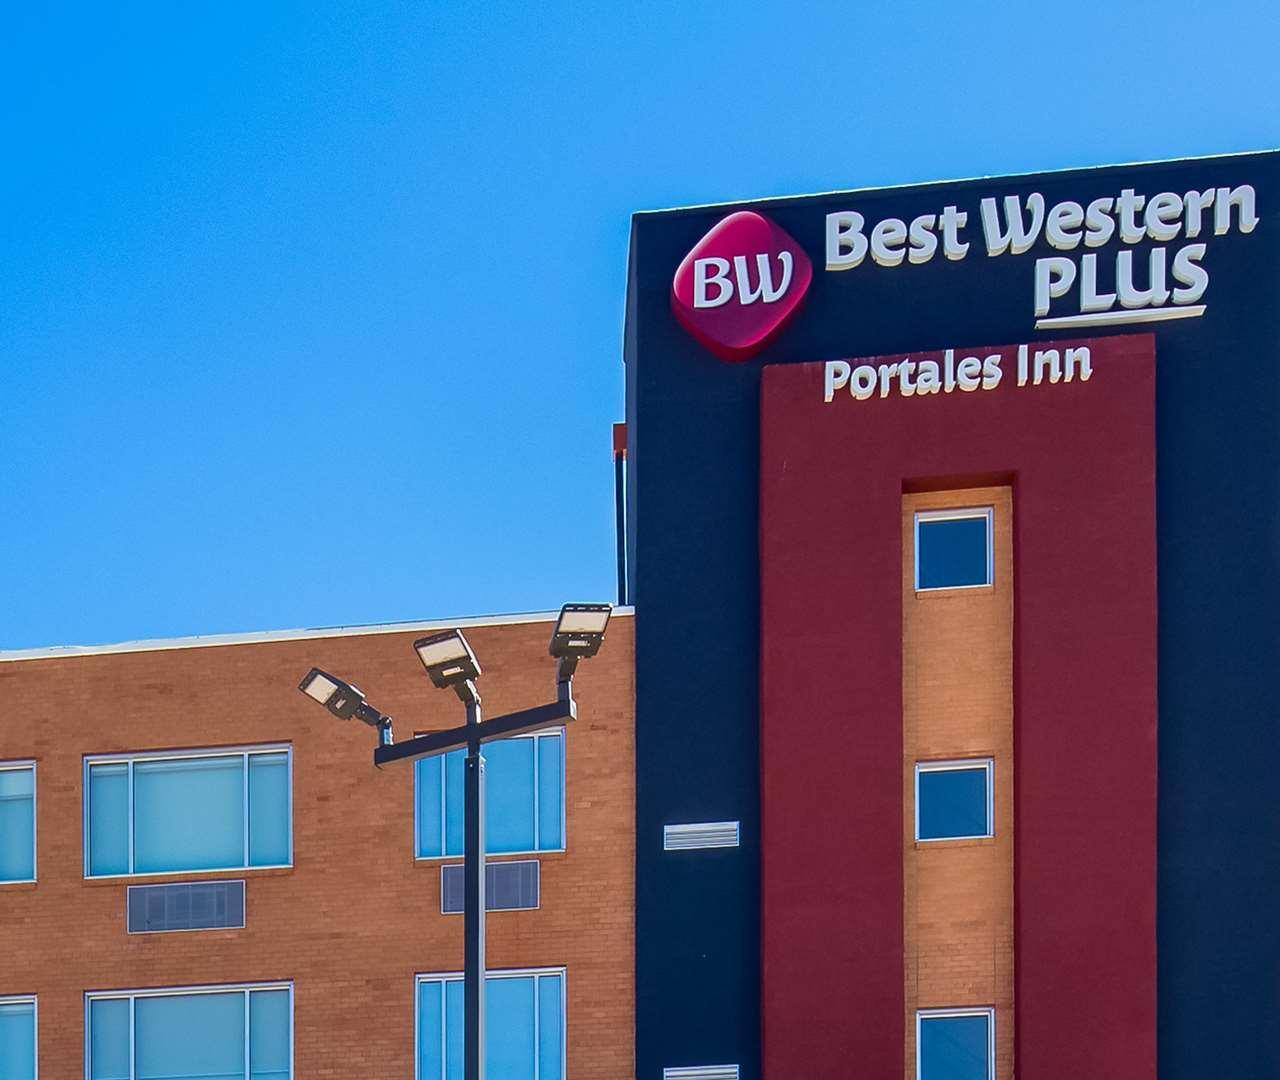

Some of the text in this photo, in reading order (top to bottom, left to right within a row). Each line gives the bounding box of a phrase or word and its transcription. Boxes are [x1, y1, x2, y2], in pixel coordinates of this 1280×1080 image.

[825, 184, 1260, 271] Best Western
[692, 251, 794, 308] BW
[1034, 243, 1210, 317] PLUS
[823, 343, 1093, 403] Portales Inn
